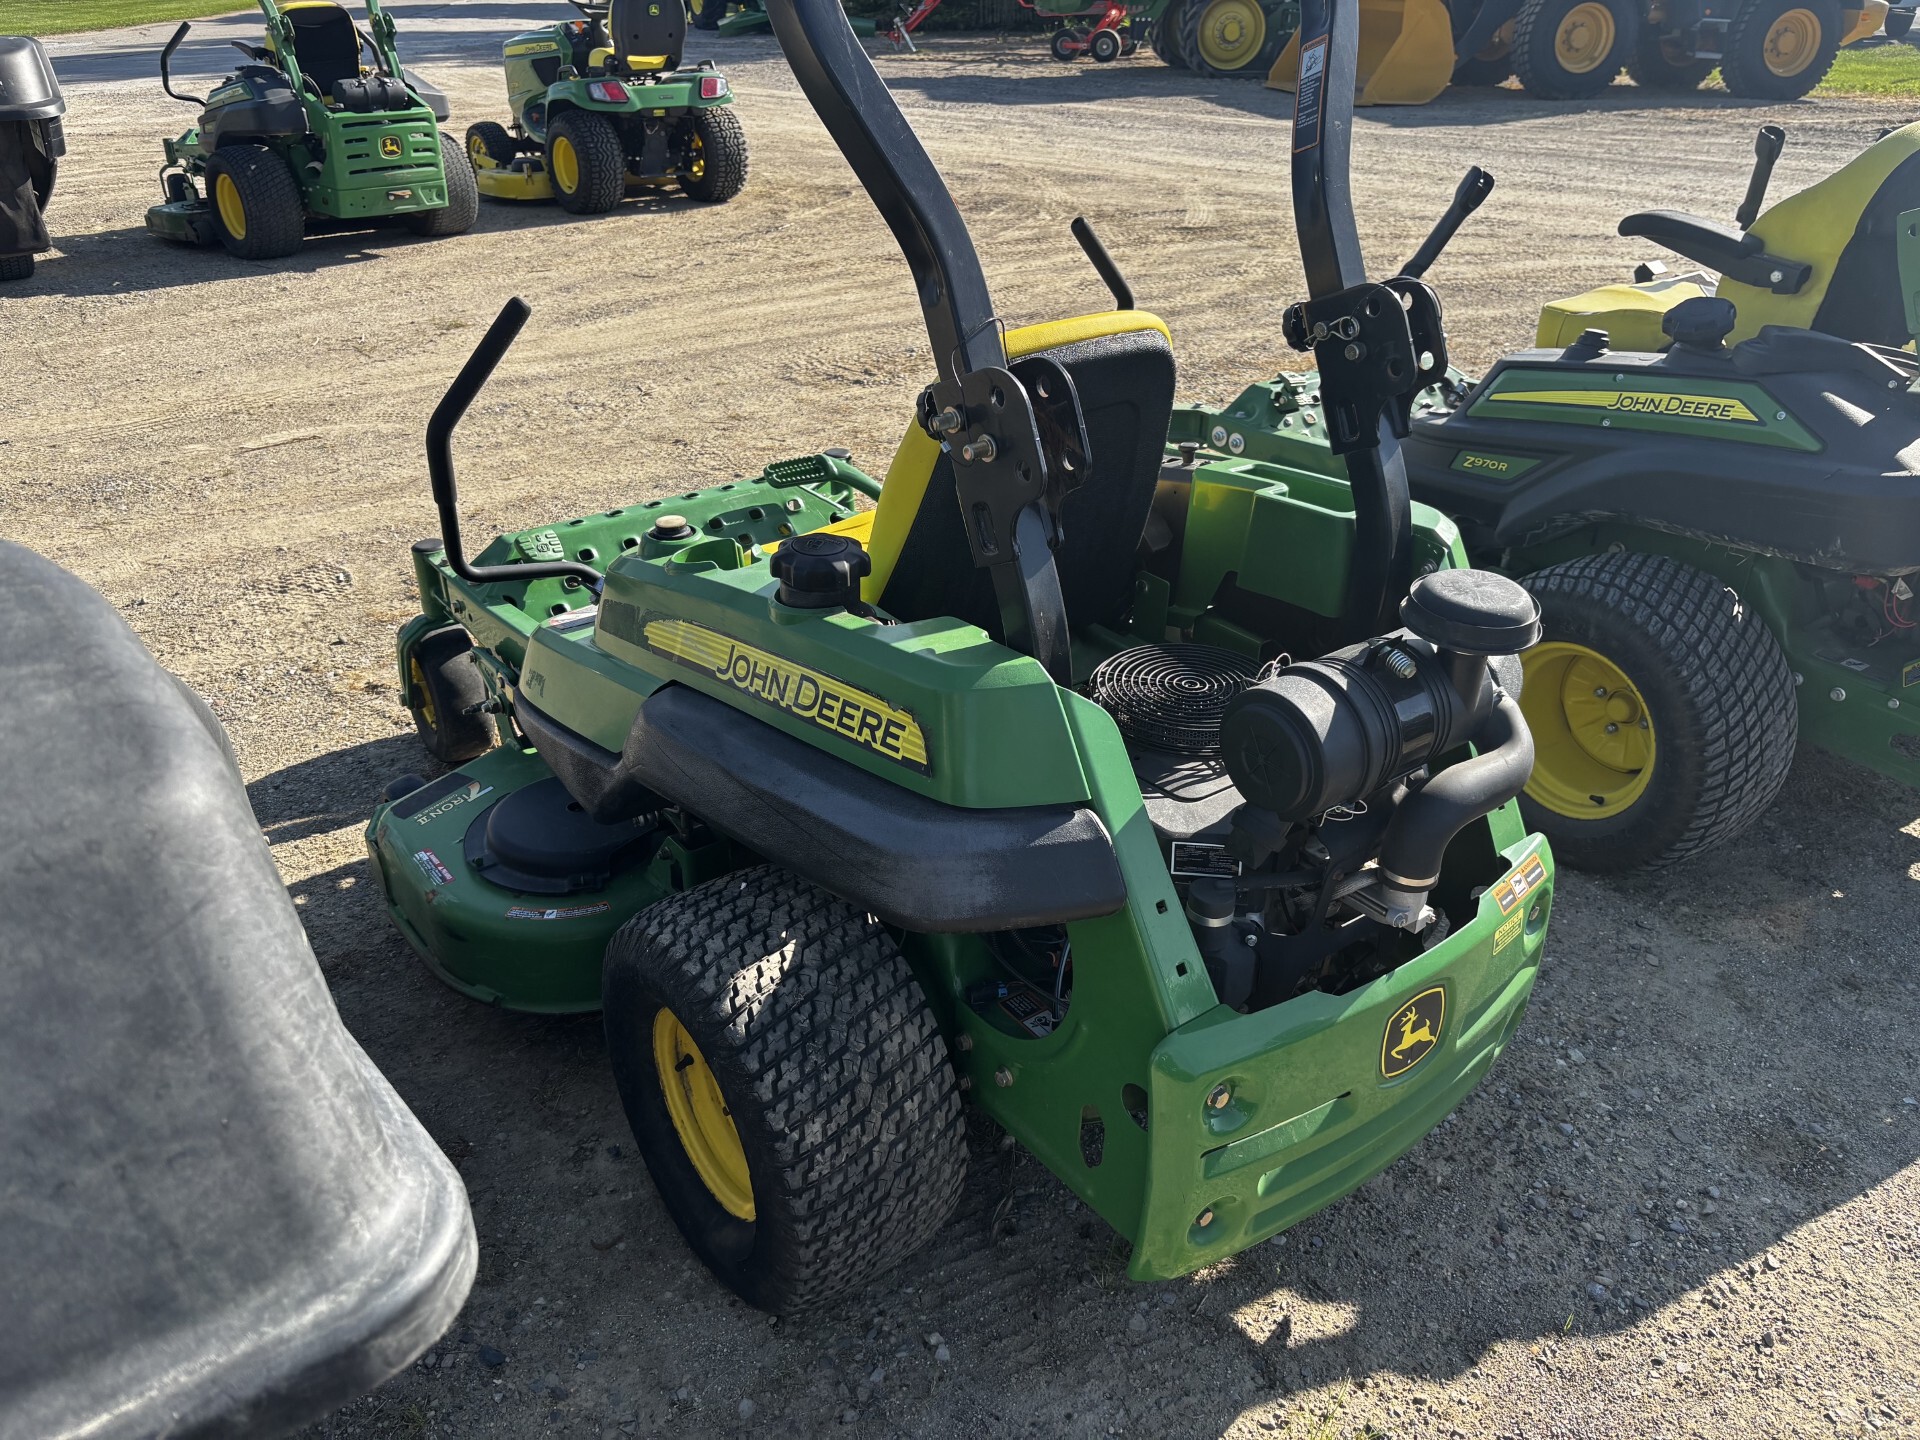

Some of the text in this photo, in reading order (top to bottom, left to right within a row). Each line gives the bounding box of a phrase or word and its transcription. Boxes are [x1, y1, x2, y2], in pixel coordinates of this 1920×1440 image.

[1607, 393, 1736, 418] JOHN DEERE
[1463, 456, 1508, 471] Z970R
[716, 643, 909, 755] JOHN DEERE
[429, 794, 469, 818] IRON
